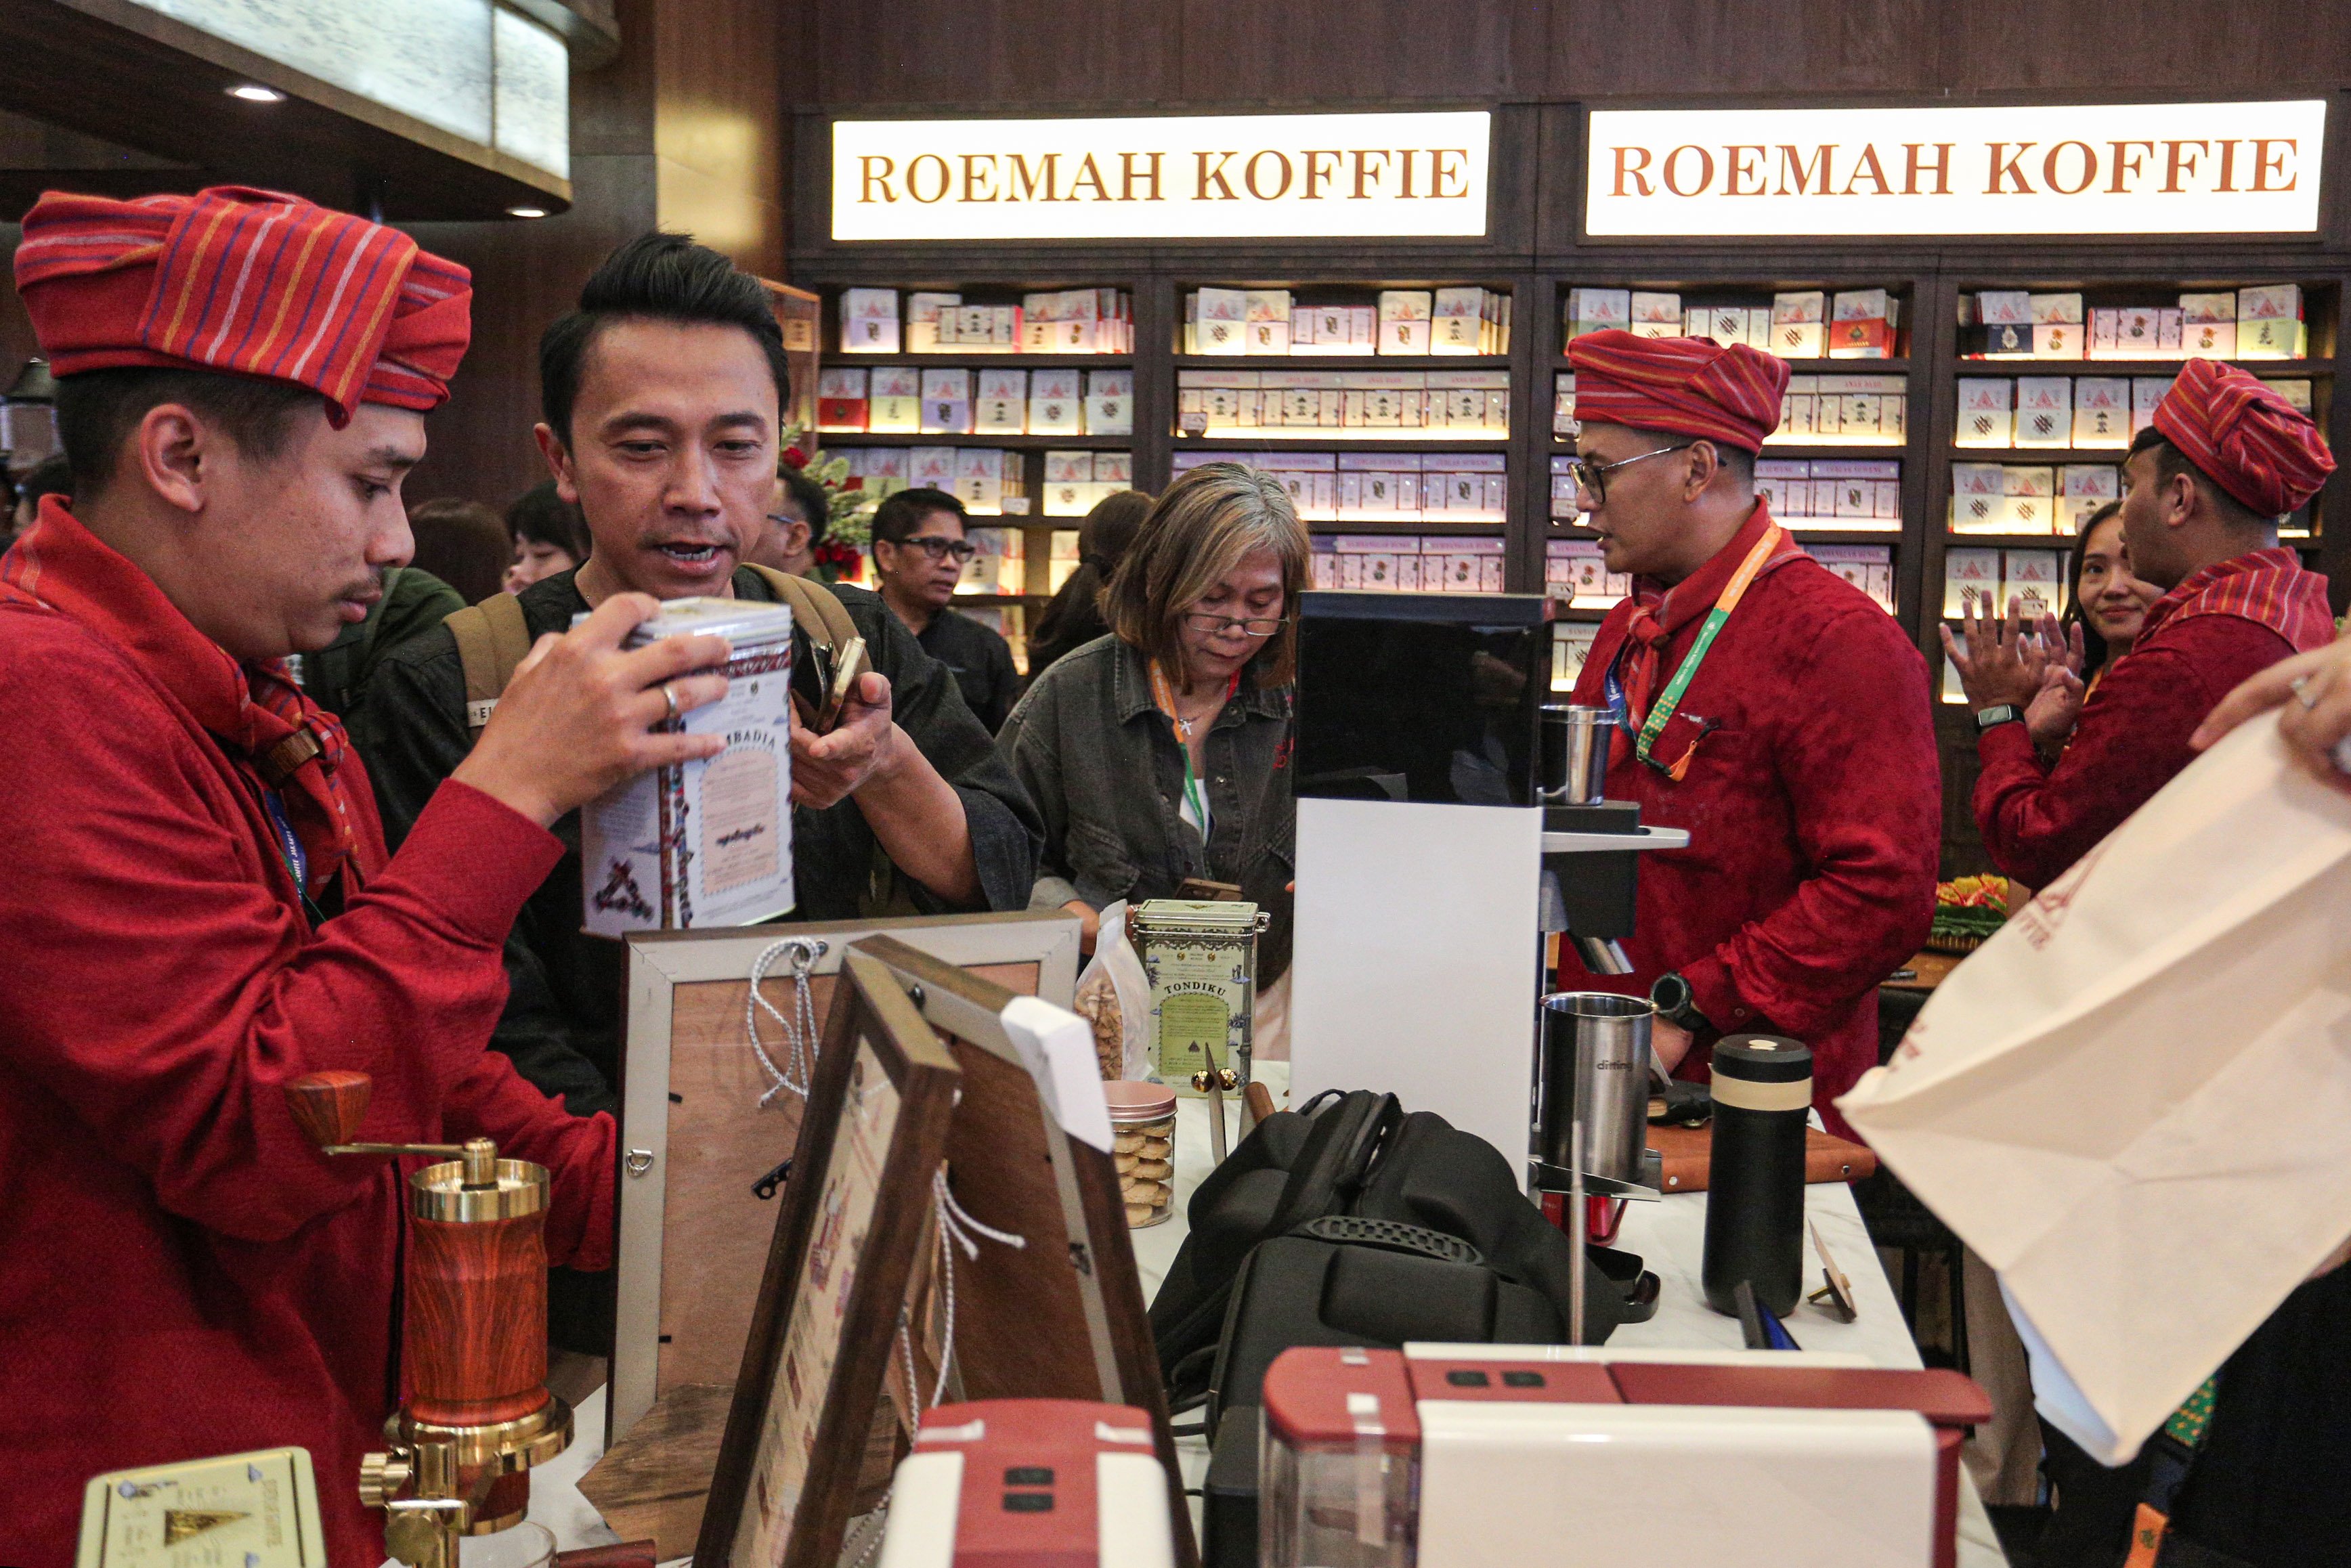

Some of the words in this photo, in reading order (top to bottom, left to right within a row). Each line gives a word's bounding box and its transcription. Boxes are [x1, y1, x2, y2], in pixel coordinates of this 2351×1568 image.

[857, 152, 1165, 203] ROEMAH
[1191, 149, 1469, 200] KOFFIE
[1607, 143, 1956, 197] ROEMAH
[1981, 139, 2297, 195] KOFFIE
[1165, 981, 1226, 996] TONDIKU
[1597, 1060, 1633, 1072] ditting
